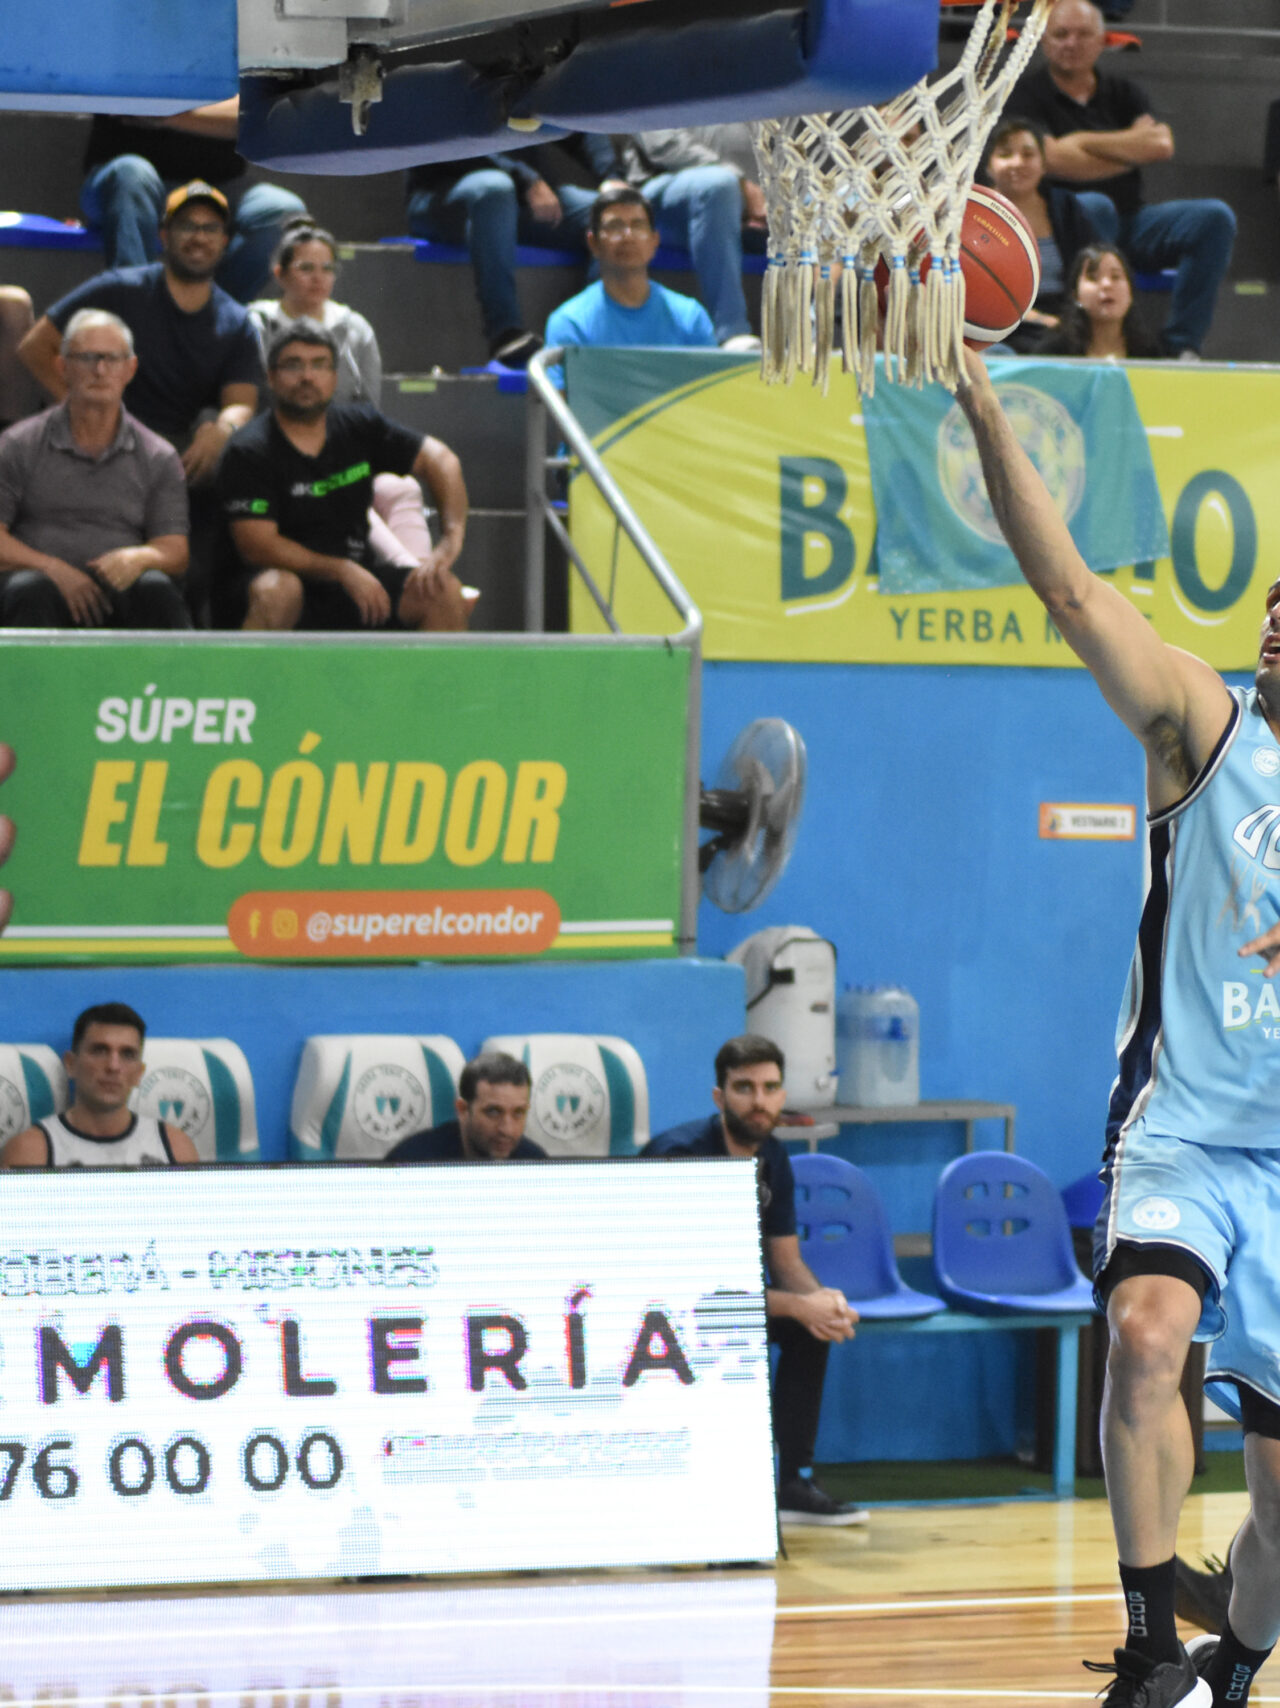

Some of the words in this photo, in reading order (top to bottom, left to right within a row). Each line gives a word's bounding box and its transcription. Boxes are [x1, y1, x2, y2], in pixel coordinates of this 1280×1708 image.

[890, 608, 1022, 644] YERBA
[95, 683, 257, 744] SÚPER
[77, 760, 169, 867] EL
[196, 730, 568, 869] CÓNDOR
[306, 905, 544, 943] @superelcondor
[37, 1281, 696, 1404] MOLERÍA
[108, 1437, 211, 1496] 00
[244, 1433, 344, 1492] 00
